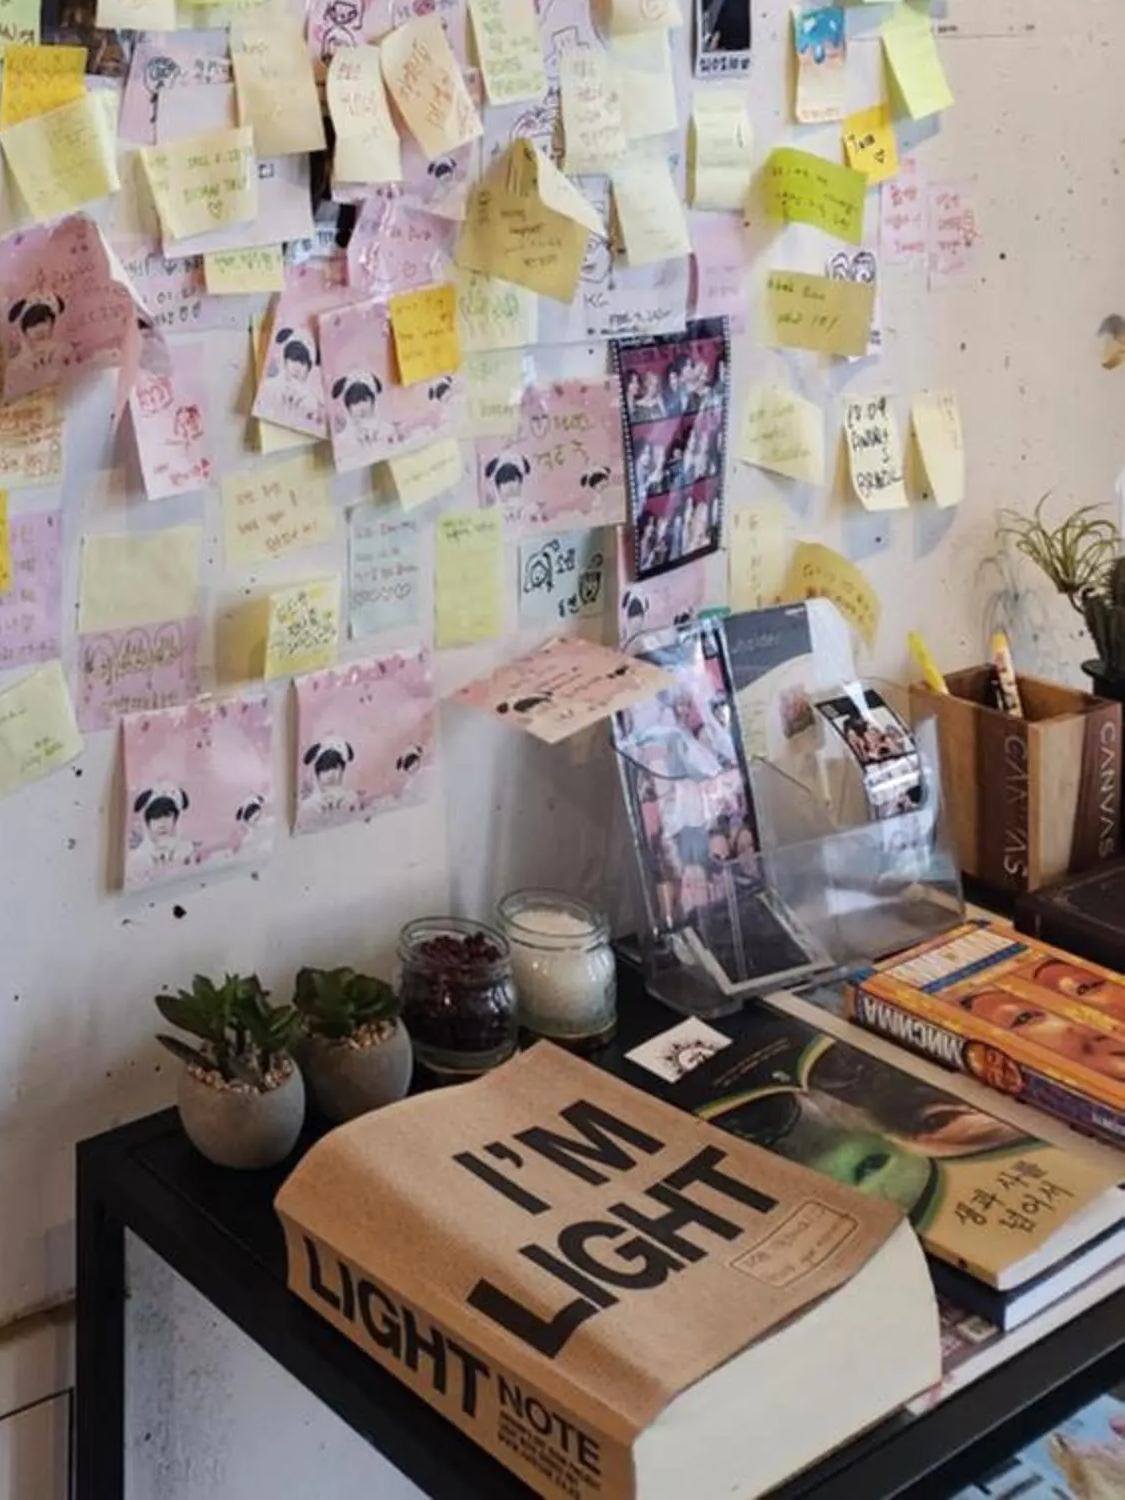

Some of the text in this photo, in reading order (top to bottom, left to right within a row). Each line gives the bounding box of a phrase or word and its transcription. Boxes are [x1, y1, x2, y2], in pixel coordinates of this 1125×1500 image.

[1097, 721, 1118, 860] CANVAS
[451, 1099, 666, 1216] I'M
[465, 1144, 781, 1359] LIGHT
[302, 1233, 492, 1422] LIGHT
[497, 1374, 604, 1484] NOTE
